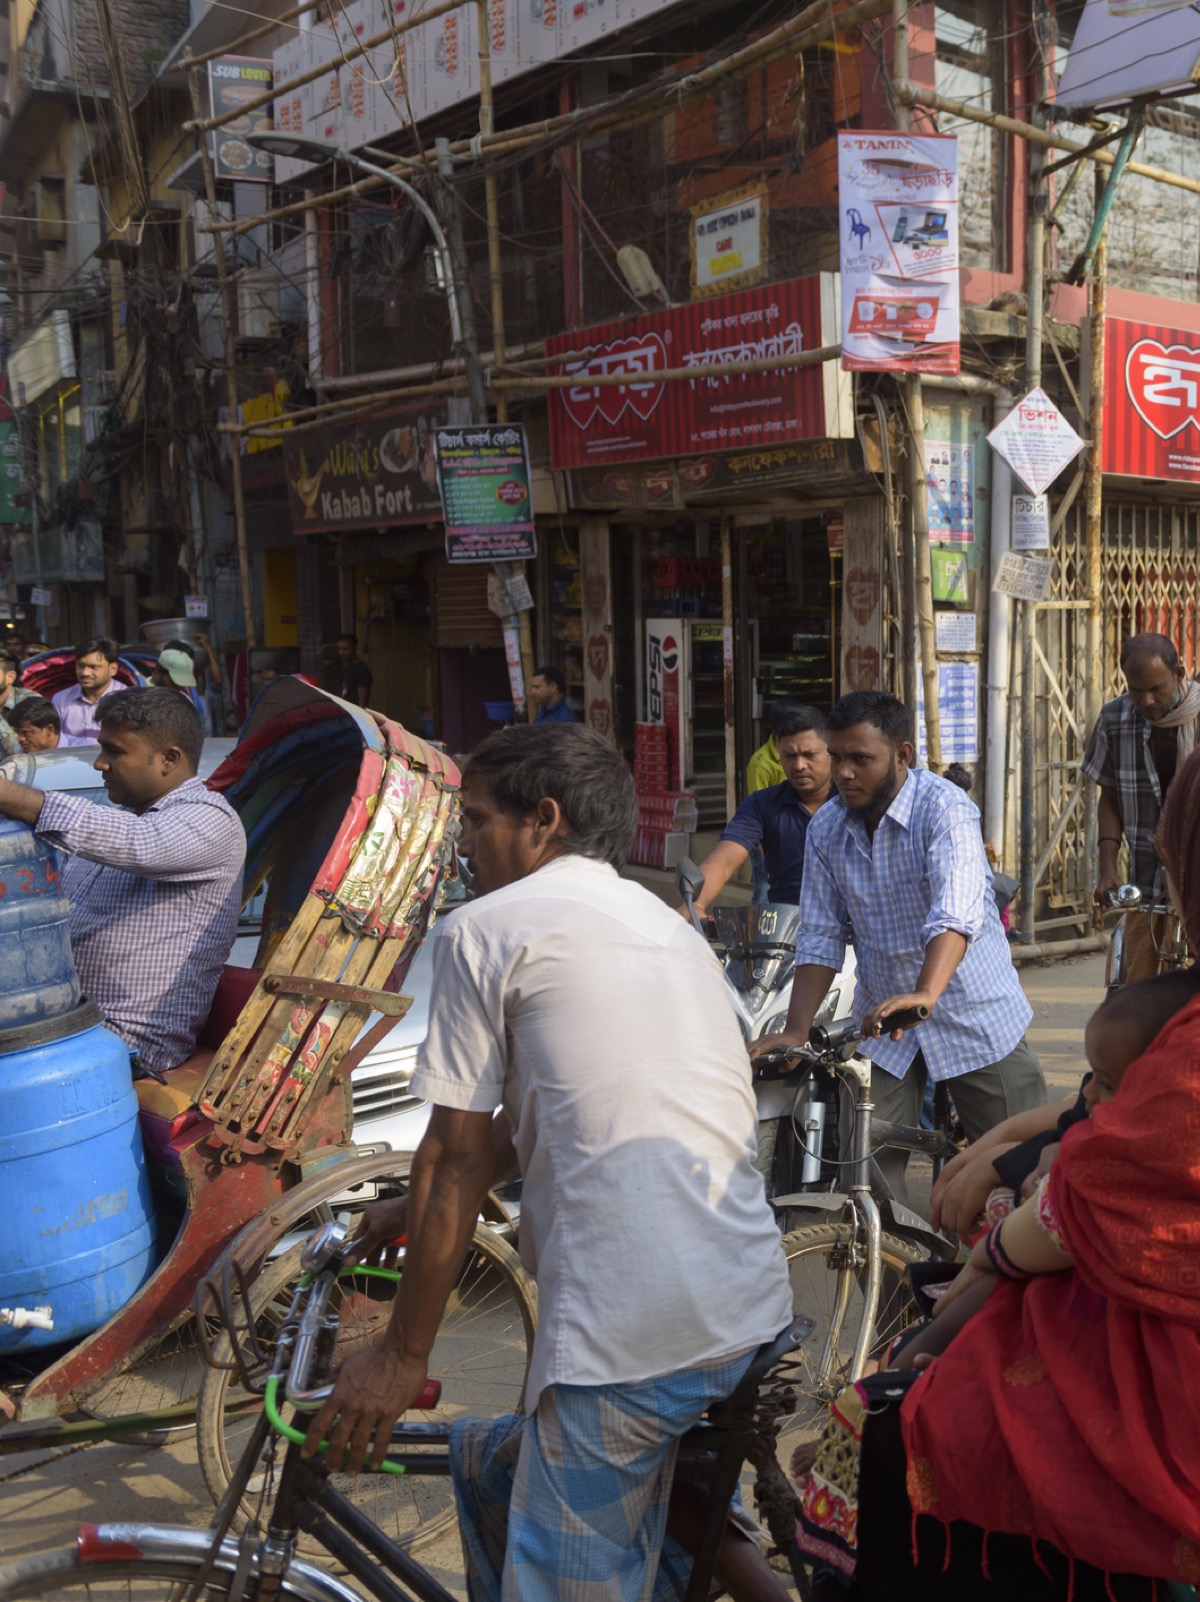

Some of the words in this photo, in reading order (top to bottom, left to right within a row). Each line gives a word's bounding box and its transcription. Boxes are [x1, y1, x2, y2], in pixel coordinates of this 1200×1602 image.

[213, 65, 240, 79] SUB
[321, 485, 372, 521] Kabab
[374, 483, 413, 516] Fort
[648, 634, 661, 722] EPSI
